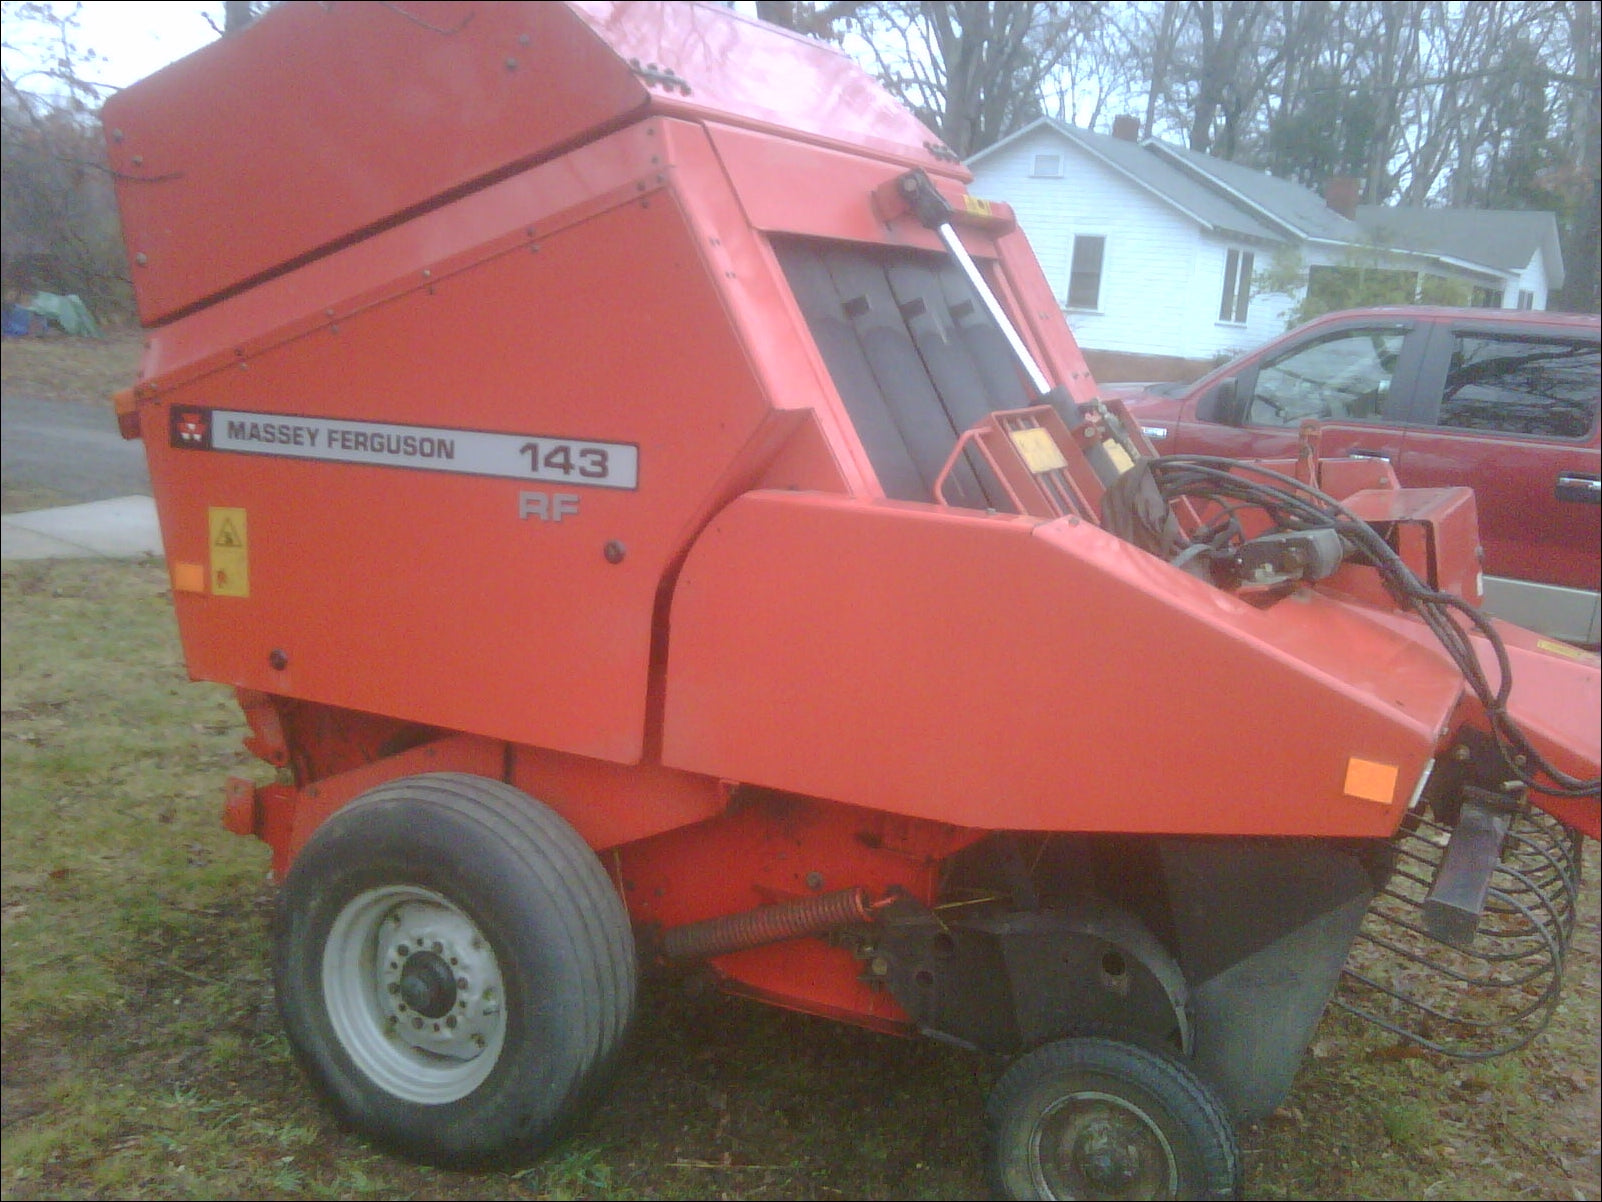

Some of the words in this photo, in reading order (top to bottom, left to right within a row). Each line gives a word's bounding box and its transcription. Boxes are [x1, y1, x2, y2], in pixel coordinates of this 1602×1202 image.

[228, 421, 318, 447] MASSEY
[328, 430, 454, 459] FERGUSON
[519, 443, 610, 479] 143
[519, 492, 580, 522] RF
